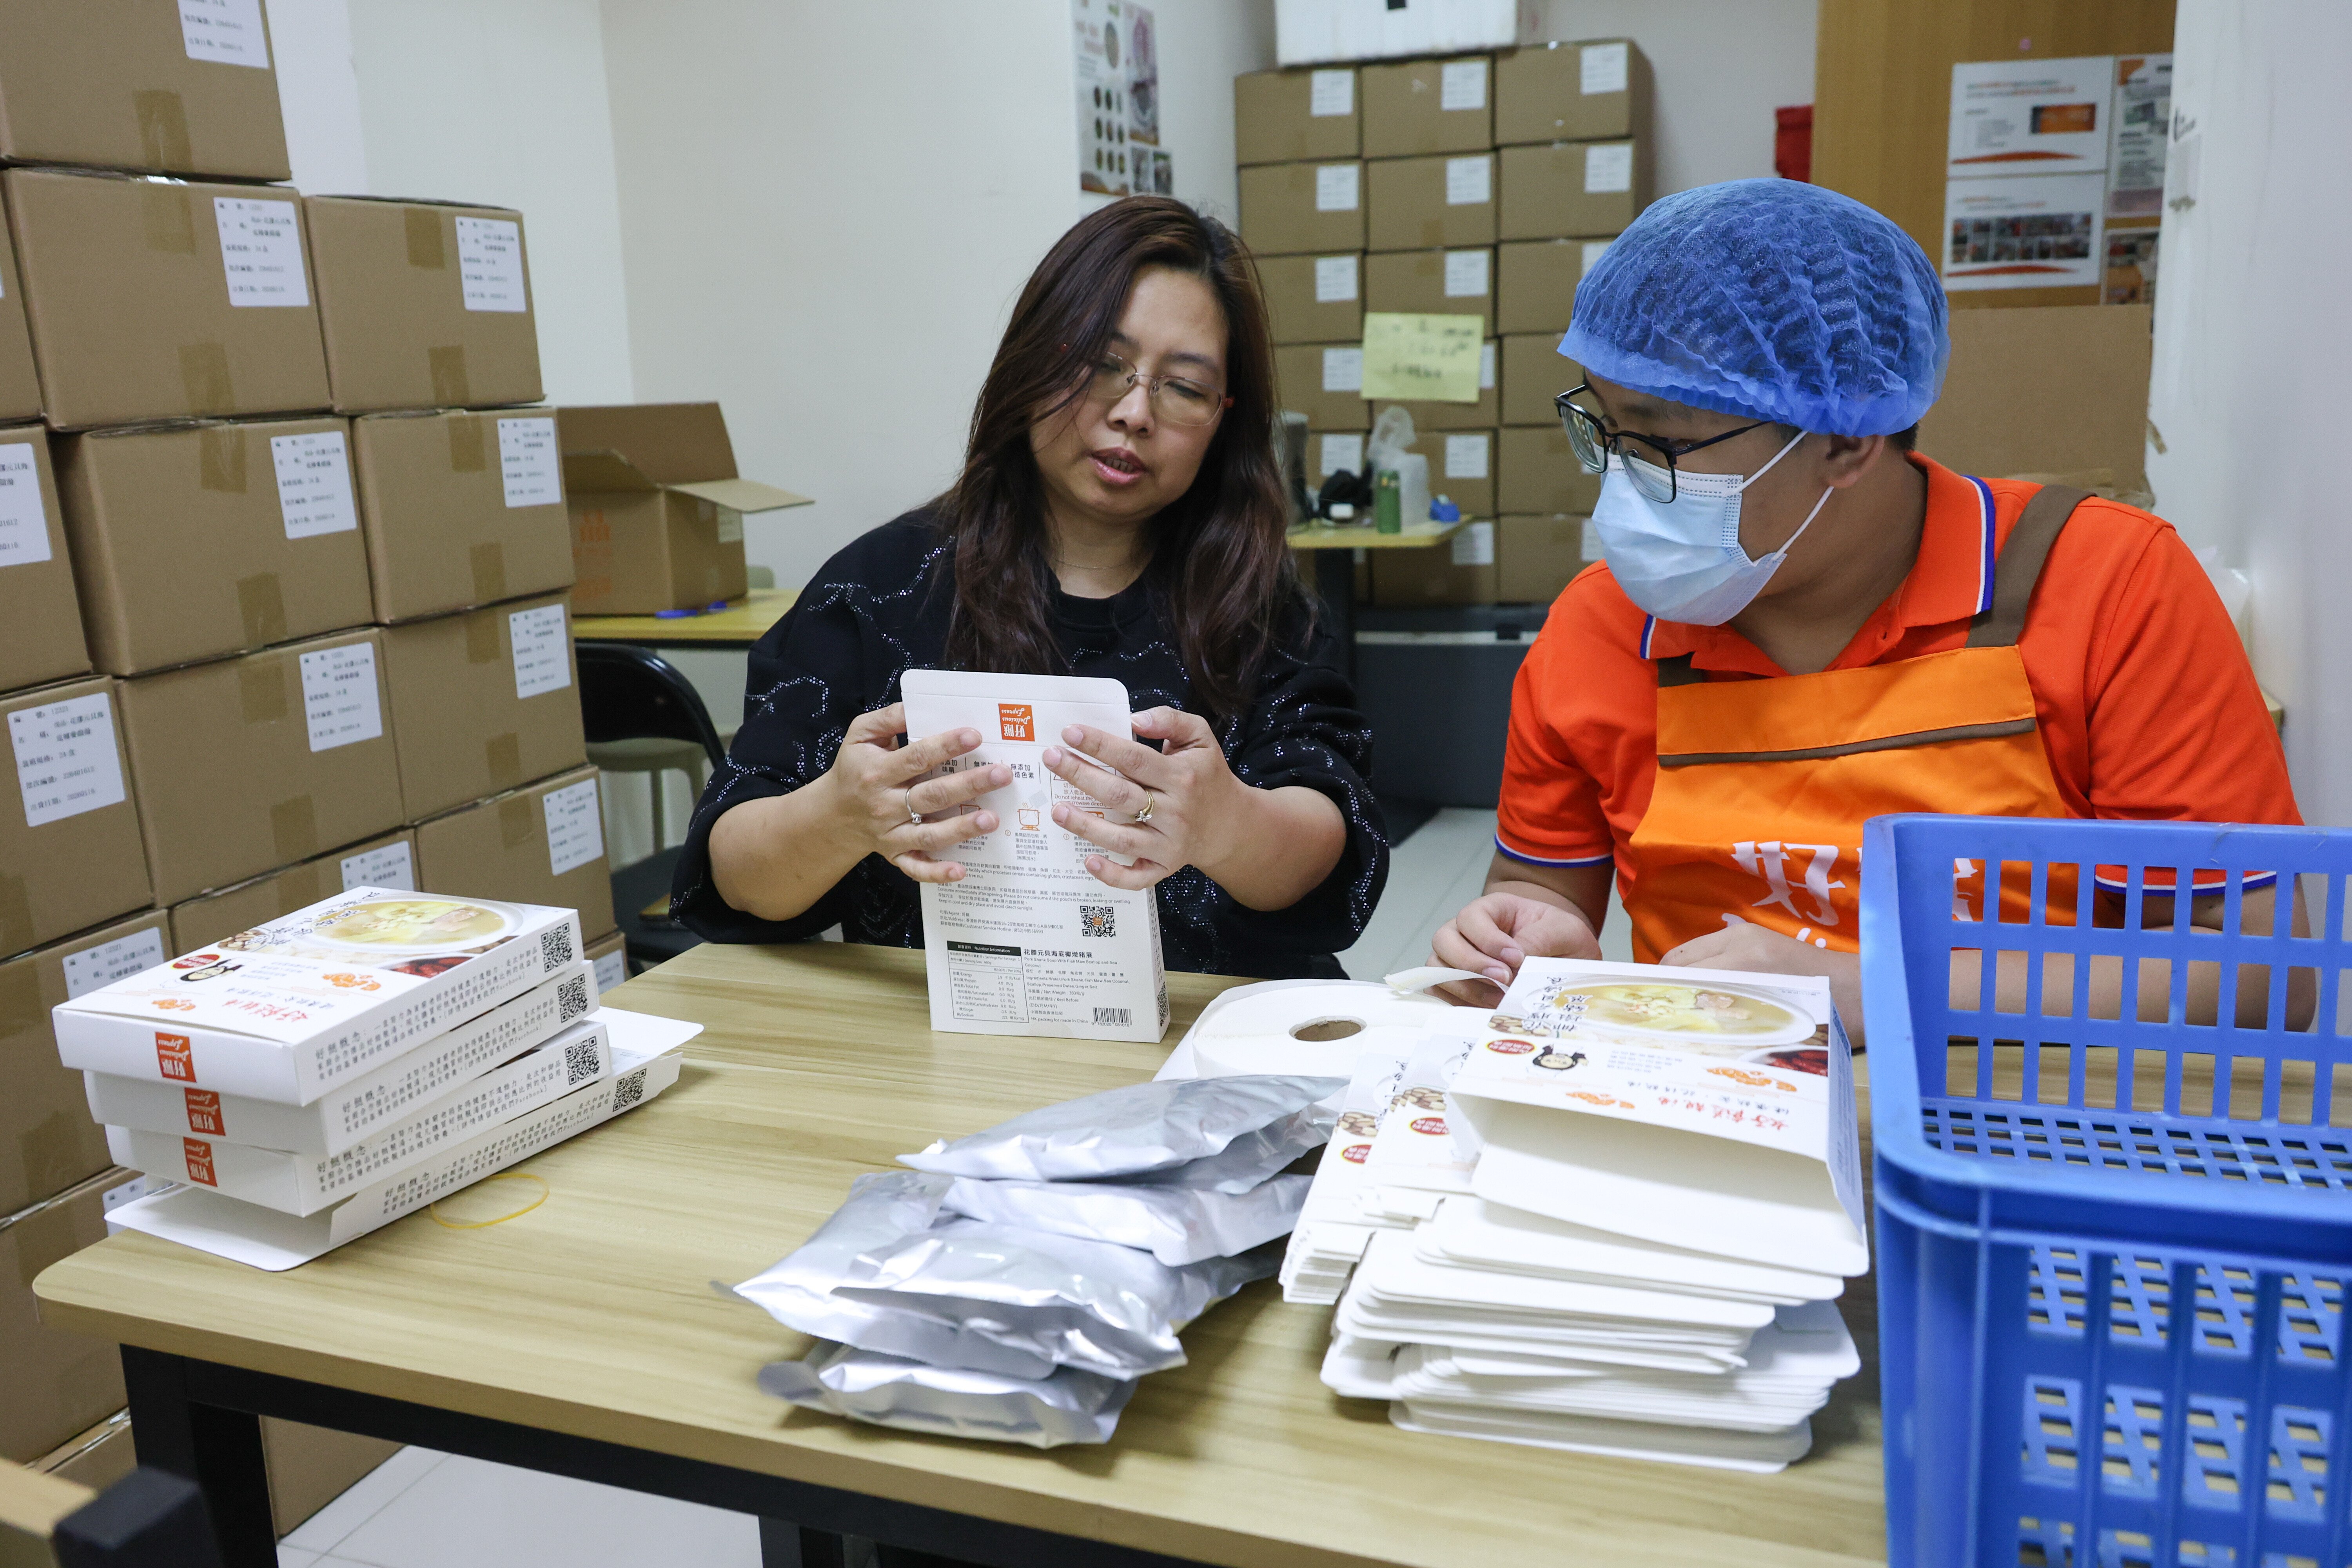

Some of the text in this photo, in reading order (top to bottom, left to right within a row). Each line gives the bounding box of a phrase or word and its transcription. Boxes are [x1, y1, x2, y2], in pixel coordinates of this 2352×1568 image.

[1001, 708, 1025, 716] Express
[1002, 716, 1031, 724] Delicious
[1024, 949, 1093, 958] 花膠元貝海底椰燉豬展
